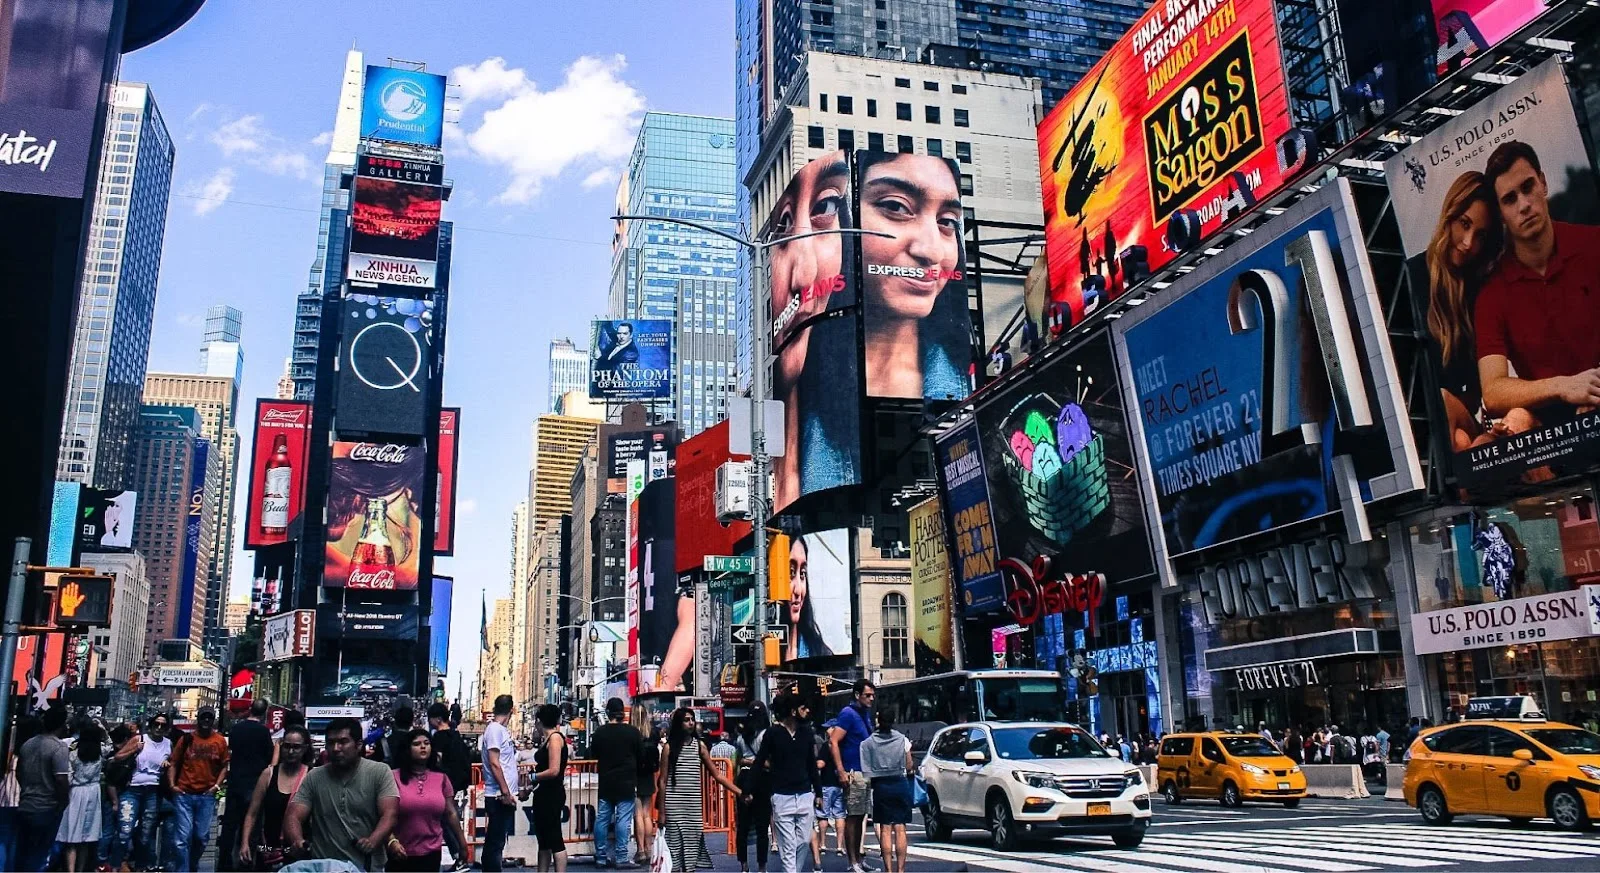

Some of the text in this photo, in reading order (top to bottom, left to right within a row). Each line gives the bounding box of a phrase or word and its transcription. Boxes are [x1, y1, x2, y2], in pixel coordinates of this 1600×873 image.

[1132, 16, 1165, 56] FINAL
[1147, 0, 1237, 101] JANUARY 14TH
[378, 118, 425, 133] Prudential
[1428, 91, 1543, 167] U.S. POLO ASSN.
[1155, 104, 1255, 206] Saigon
[1454, 128, 1516, 167] SINCE 1890
[369, 167, 430, 181] GALLERY
[403, 162, 431, 172] XINHUA
[355, 270, 429, 285] NEWS AGENCY
[367, 260, 418, 275] XINHUA
[867, 264, 925, 278] EXPRESS
[773, 274, 846, 337] EXPRESS JEANS
[350, 322, 421, 392] Q
[620, 362, 639, 370] THE
[591, 368, 669, 382] PHANTOM
[597, 380, 661, 388] OF THE OPERA
[1137, 355, 1168, 396] MEET
[1144, 366, 1228, 425] RACHEL
[1150, 389, 1262, 462] @ FOREVER 21
[350, 441, 408, 463] Coca-Cola
[956, 450, 980, 477] MUSICAL
[1158, 458, 1194, 496] TIMES
[1194, 438, 1242, 487] SQUARE
[1471, 446, 1500, 463] LIVE
[1472, 460, 1494, 472] PAMELA
[1494, 451, 1526, 465] FLANAGAN
[1533, 444, 1555, 455] JONNY
[1556, 436, 1580, 447] LAVINE
[953, 501, 990, 535] COME
[715, 558, 725, 570] W
[729, 558, 741, 570] 45
[913, 535, 945, 567] POTTE
[962, 546, 996, 582] AWAY
[348, 567, 395, 589] Coca-Cola
[1196, 534, 1374, 625] FOREVER
[1428, 596, 1585, 635] U.S. POLO ASSN.
[739, 629, 755, 639] ONE
[1463, 627, 1546, 646] SINCE 1890
[1236, 661, 1320, 692] FOREVER 21
